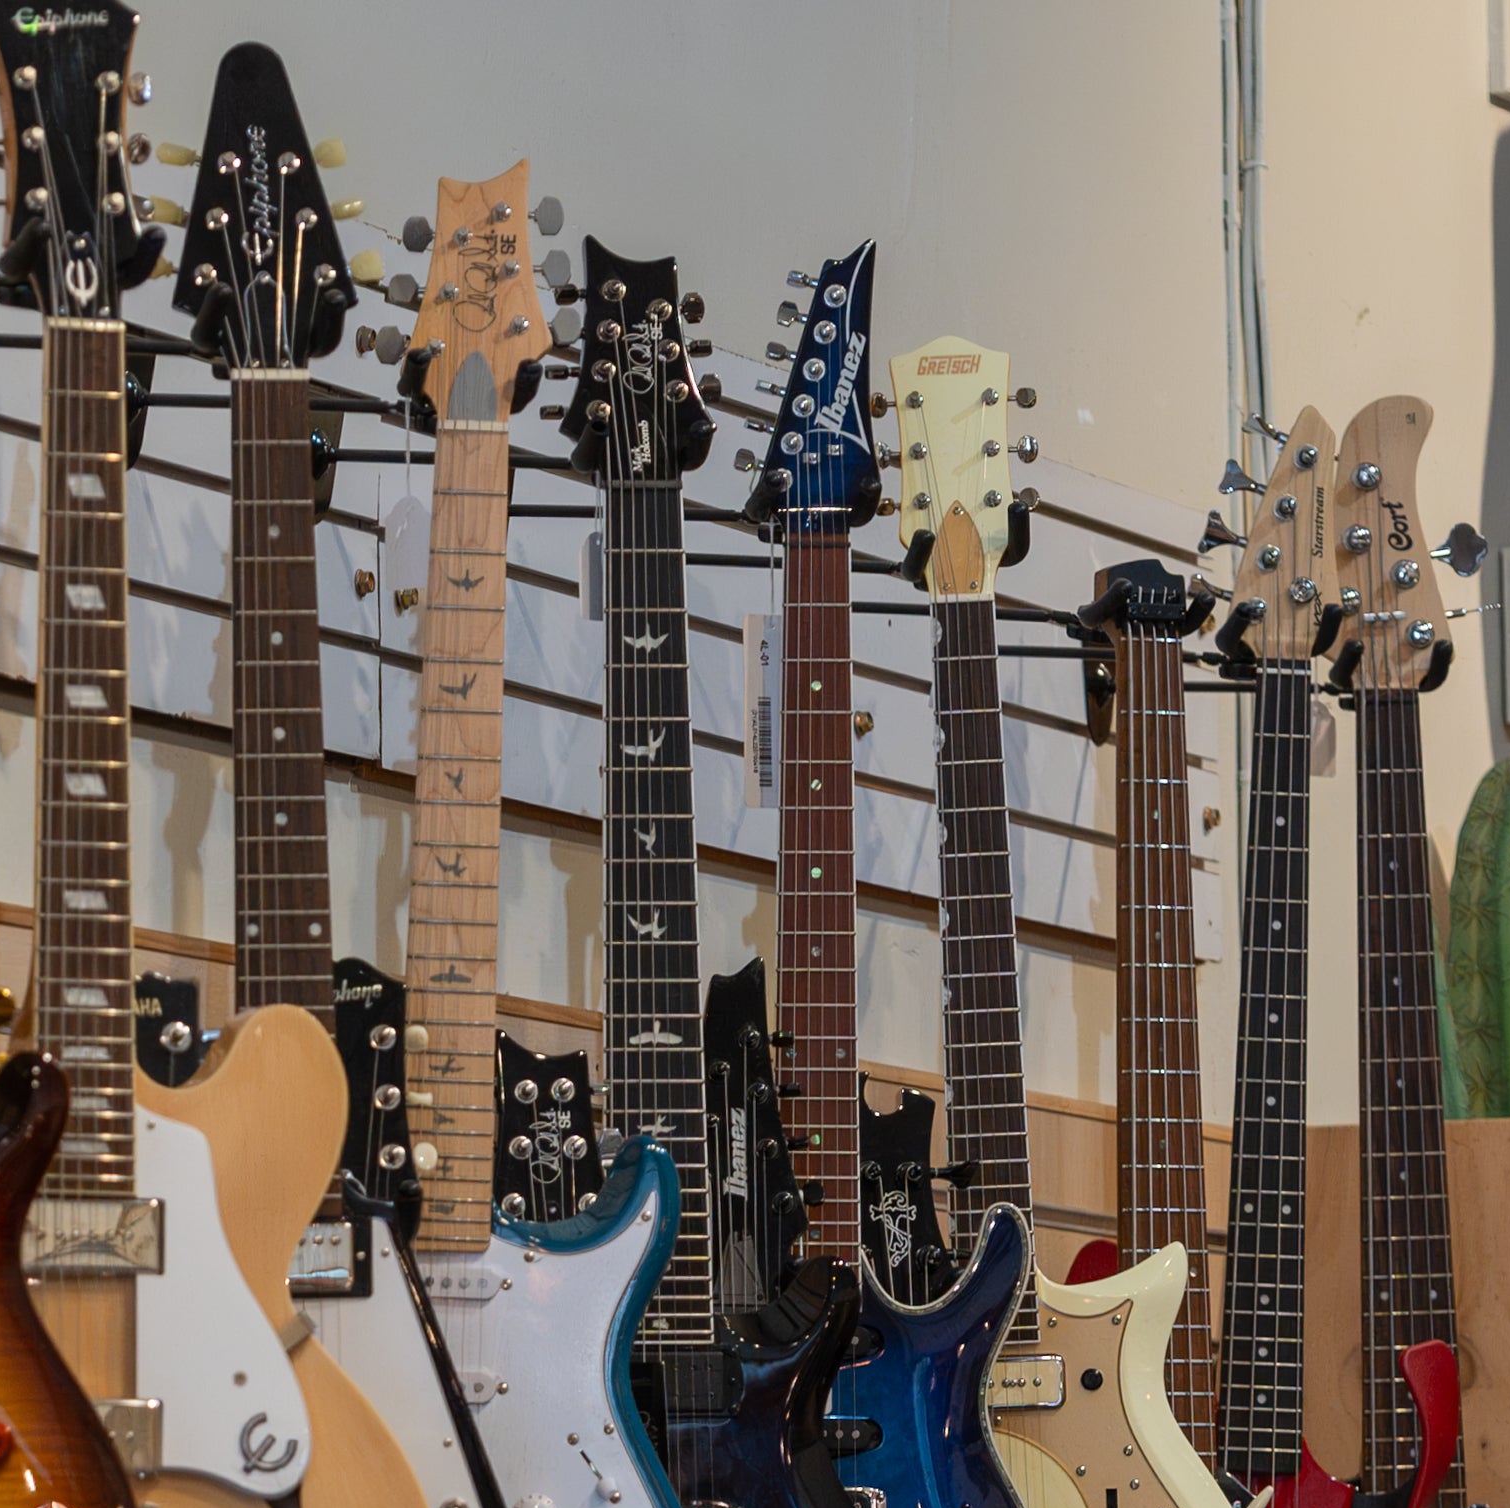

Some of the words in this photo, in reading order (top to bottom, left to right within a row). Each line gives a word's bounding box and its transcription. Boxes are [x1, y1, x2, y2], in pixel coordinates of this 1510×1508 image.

[11, 7, 109, 35] Epiphone
[242, 125, 279, 266] Epiphone
[500, 234, 516, 255] SE
[651, 321, 662, 340] SE
[917, 354, 982, 376] GRETSCH
[814, 331, 867, 439] Ibanez
[641, 420, 651, 463] Holcomb
[633, 446, 642, 472] Mark
[1312, 487, 1325, 558] Starstream
[1380, 497, 1413, 551] Cort
[760, 639, 770, 667] 4L-01
[558, 1110, 571, 1129] SE
[723, 1107, 747, 1200] Ibanez
